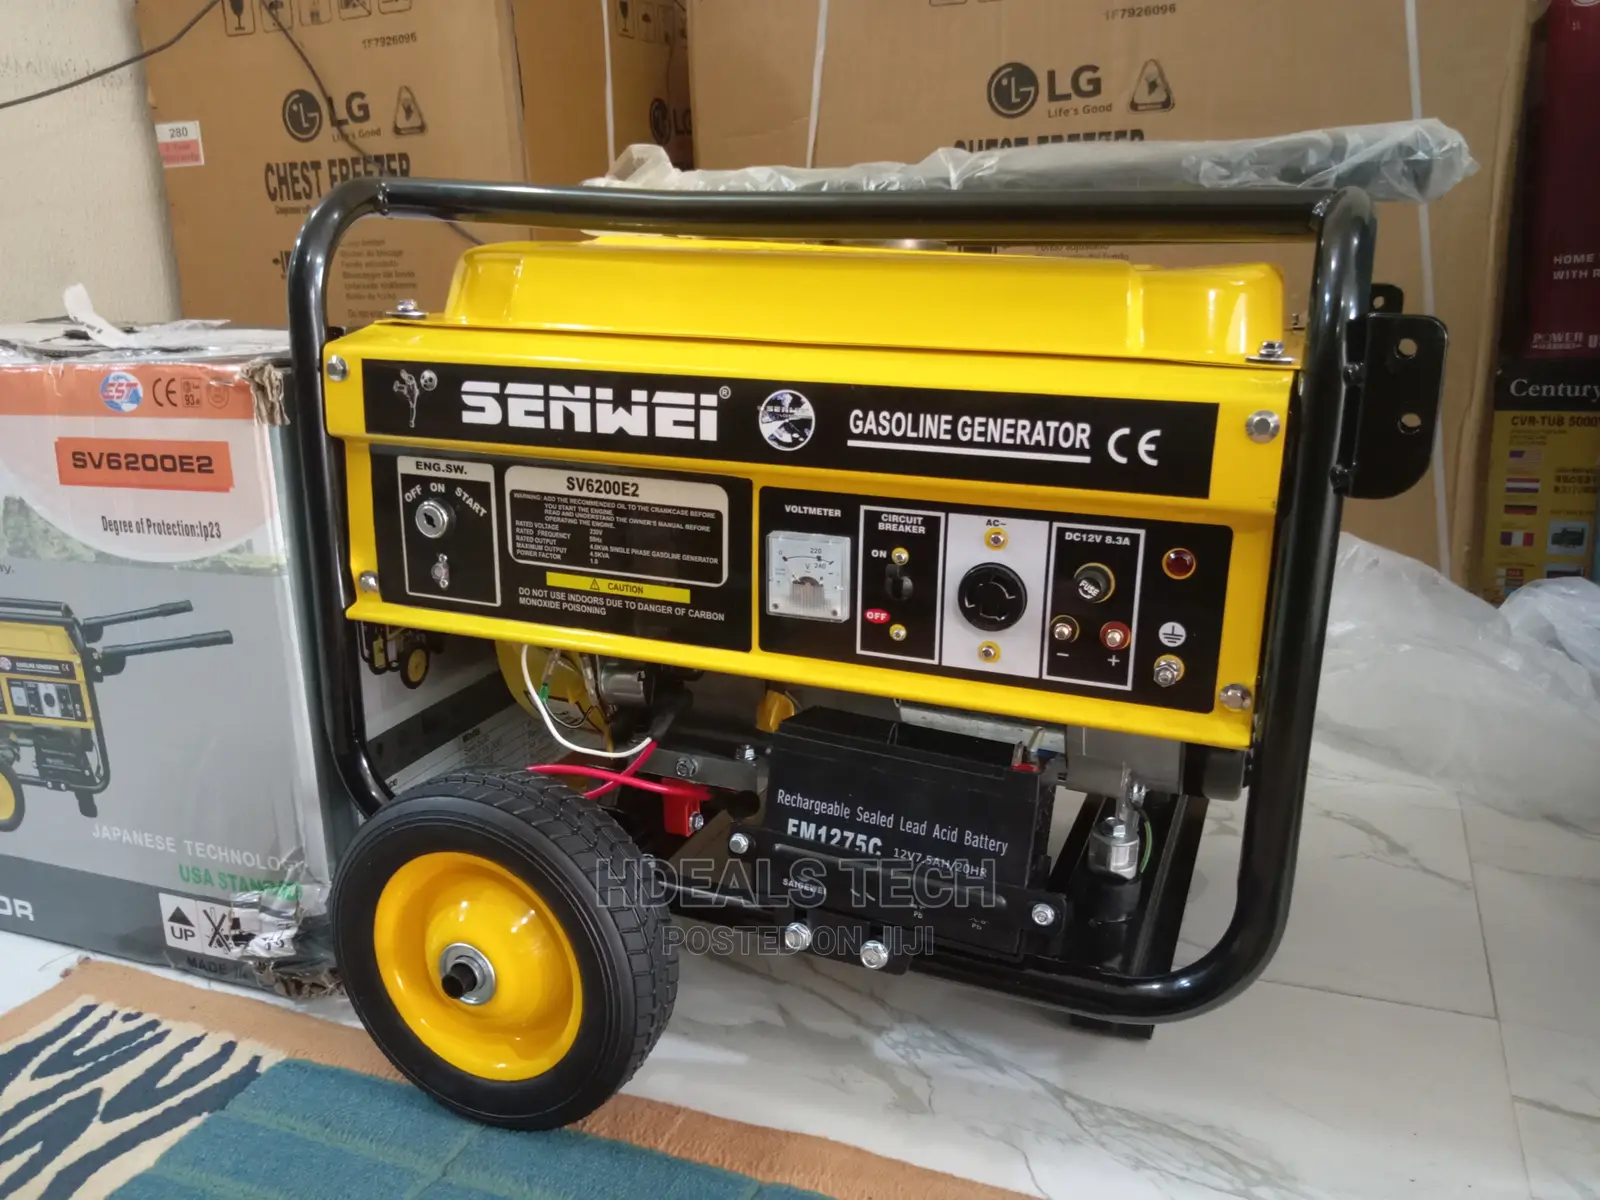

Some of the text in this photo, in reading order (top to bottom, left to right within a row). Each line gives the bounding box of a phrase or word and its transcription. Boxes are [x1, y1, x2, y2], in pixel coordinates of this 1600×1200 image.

[1047, 65, 1101, 103] LG
[327, 91, 370, 128] LG
[1048, 103, 1113, 119] Life's Good
[169, 126, 188, 139] 280
[265, 160, 322, 202] CHEST
[1553, 253, 1594, 264] HOME
[1553, 269, 1588, 280] WITH
[1509, 378, 1600, 404] Century
[460, 380, 718, 441] SENWEI
[849, 409, 952, 441] GASOLINE
[957, 418, 1092, 450] GENERATOR
[1107, 427, 1162, 467] CE
[72, 451, 215, 475] SV6200E2
[415, 460, 468, 475] ENG.SW.
[566, 476, 640, 498] SV6200E2
[404, 482, 488, 518] OFF ON START
[784, 504, 842, 518] VOLTMETER
[881, 513, 924, 525] CIRCUIT
[101, 515, 134, 536] Degree
[135, 517, 147, 533] of
[878, 522, 926, 535] BREAKER
[1064, 531, 1131, 546] DC12V 8.3A
[871, 549, 887, 559] ON
[607, 582, 644, 595] CAUTION
[1078, 579, 1100, 597] FUSE
[518, 587, 726, 622] DO NOT USE INDOORS DUE TO DANGER OF CARBON
[518, 596, 607, 616] MONOXIDE POISONING
[866, 611, 887, 621] OFF
[777, 789, 1008, 856] Rechargeable Sealed Lead Acid Battery
[92, 823, 177, 853] JAPANESE
[184, 839, 296, 872] TECHNOLO
[178, 863, 214, 886] USA
[171, 926, 196, 941] UP
[186, 956, 230, 975] MADE
